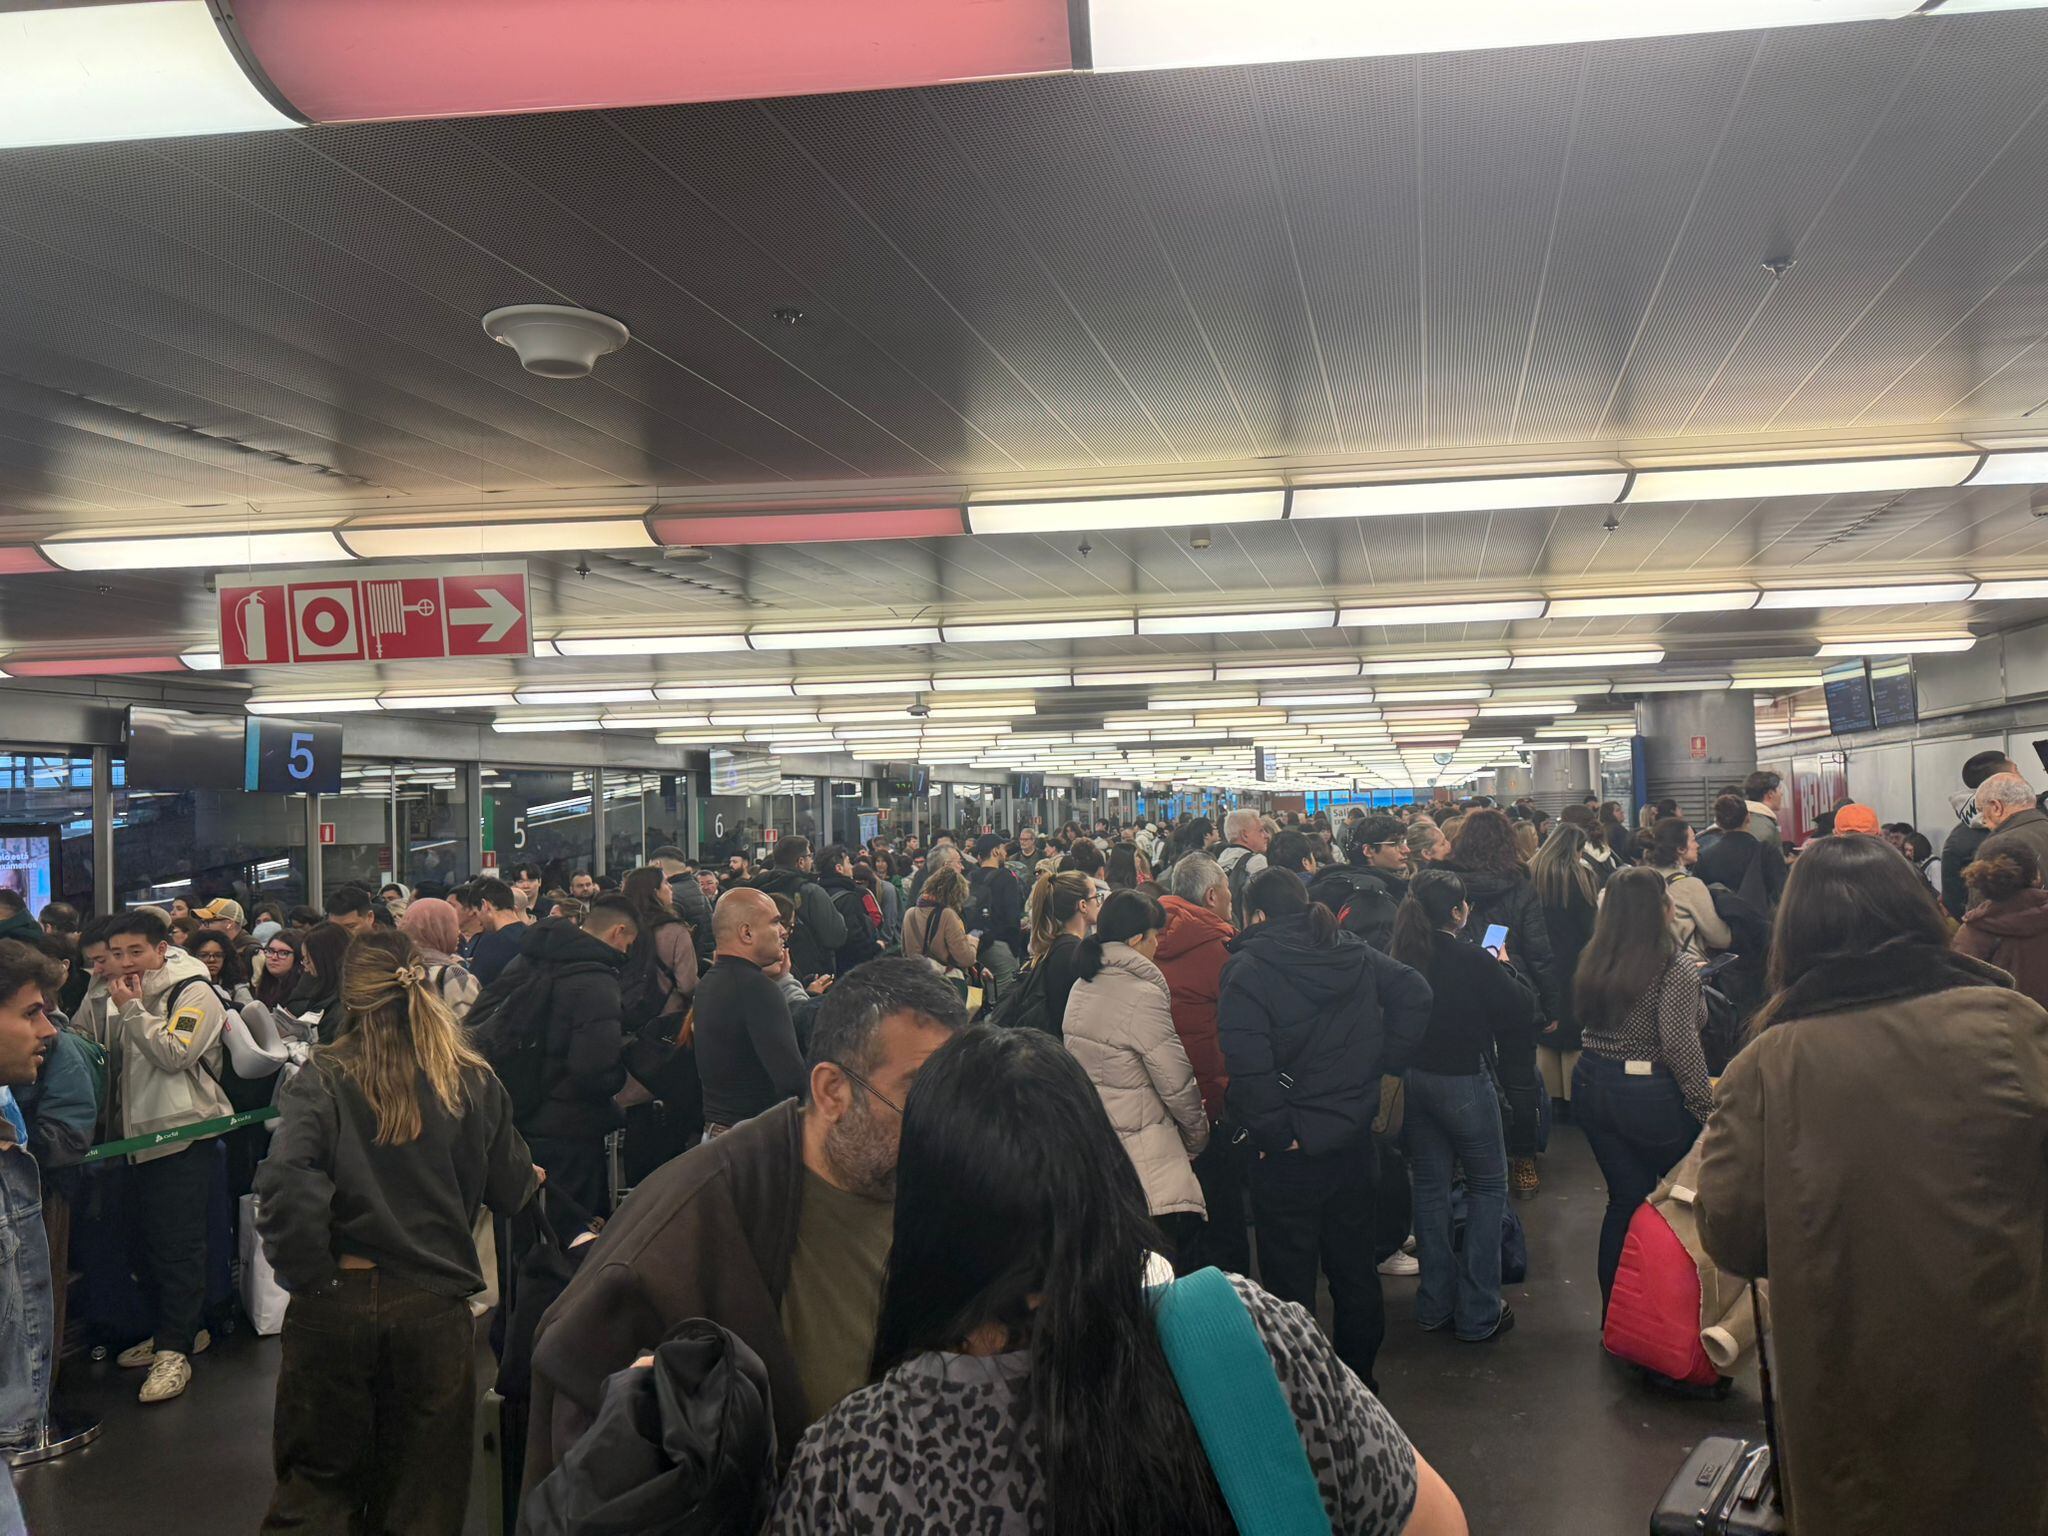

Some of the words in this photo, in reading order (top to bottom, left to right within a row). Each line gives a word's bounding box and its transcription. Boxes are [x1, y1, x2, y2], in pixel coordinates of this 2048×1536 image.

[287, 732, 314, 779] 5
[727, 760, 737, 788] 6
[918, 770, 926, 791] 7
[514, 817, 526, 849] 5
[715, 813, 724, 838] 6
